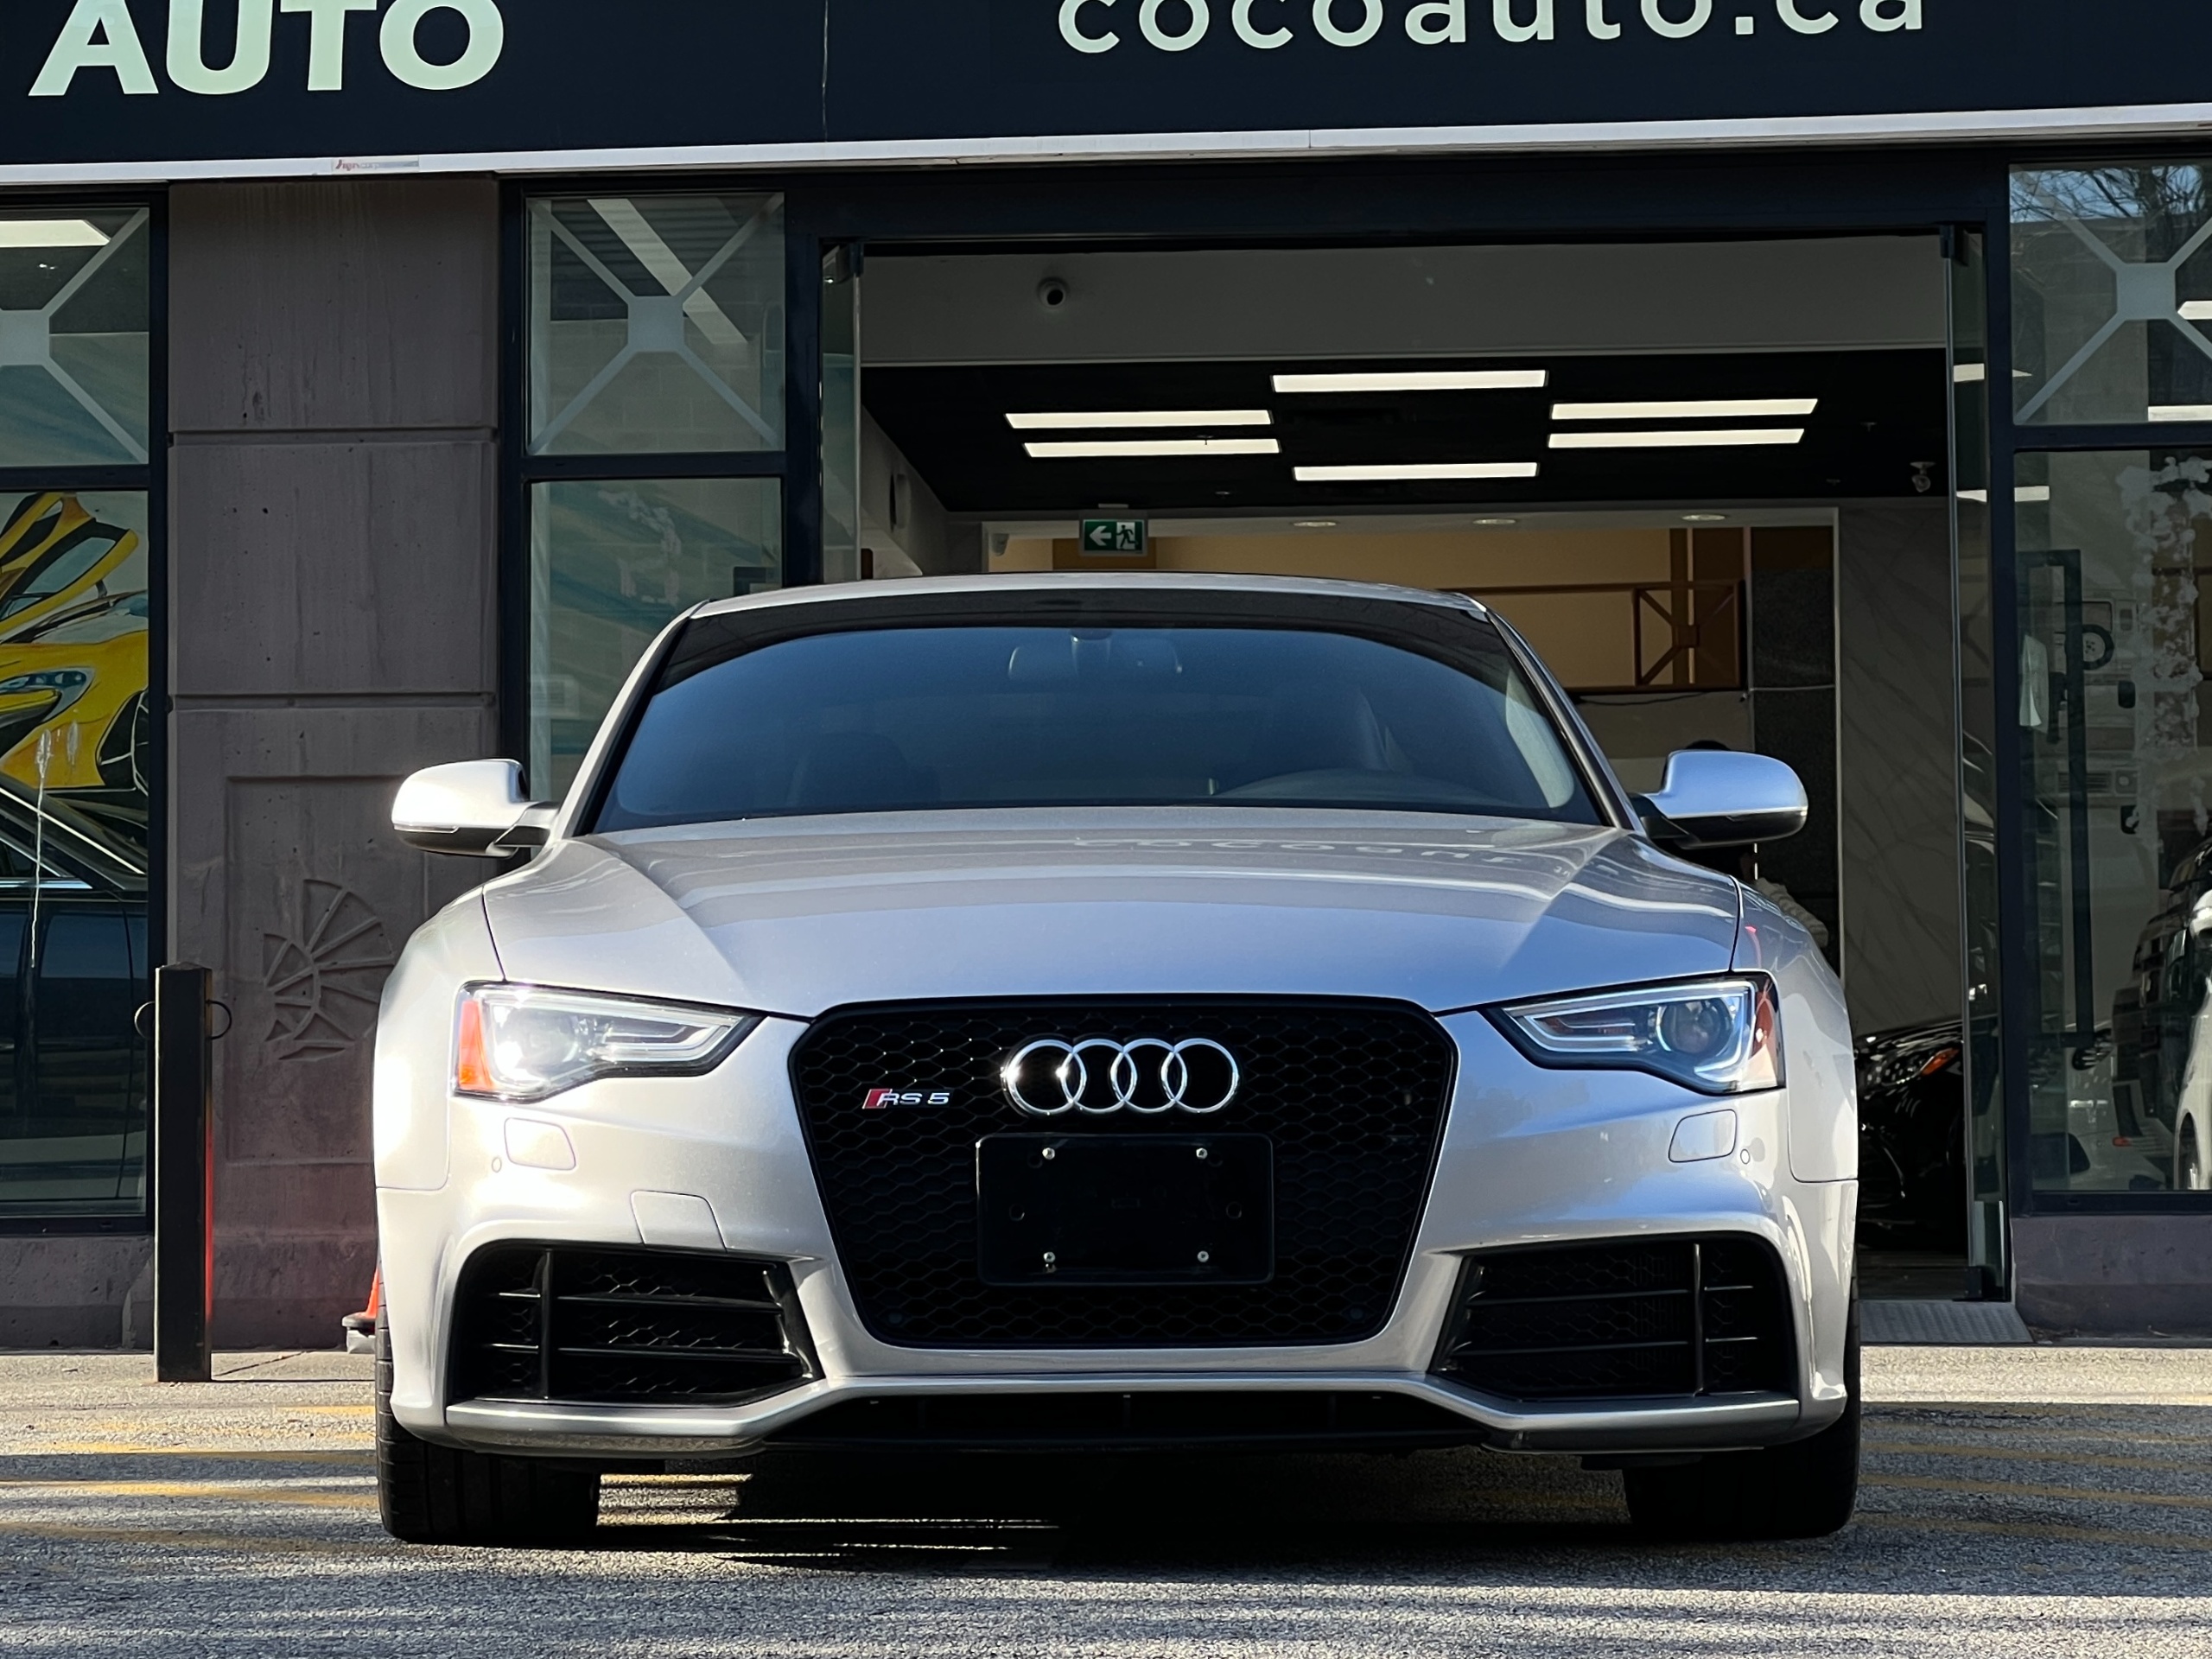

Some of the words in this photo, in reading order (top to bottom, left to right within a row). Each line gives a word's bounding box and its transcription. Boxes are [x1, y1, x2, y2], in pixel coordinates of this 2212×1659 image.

[29, 0, 504, 97] AUTO
[876, 1091, 923, 1108] RS
[927, 1092, 950, 1105] 5
